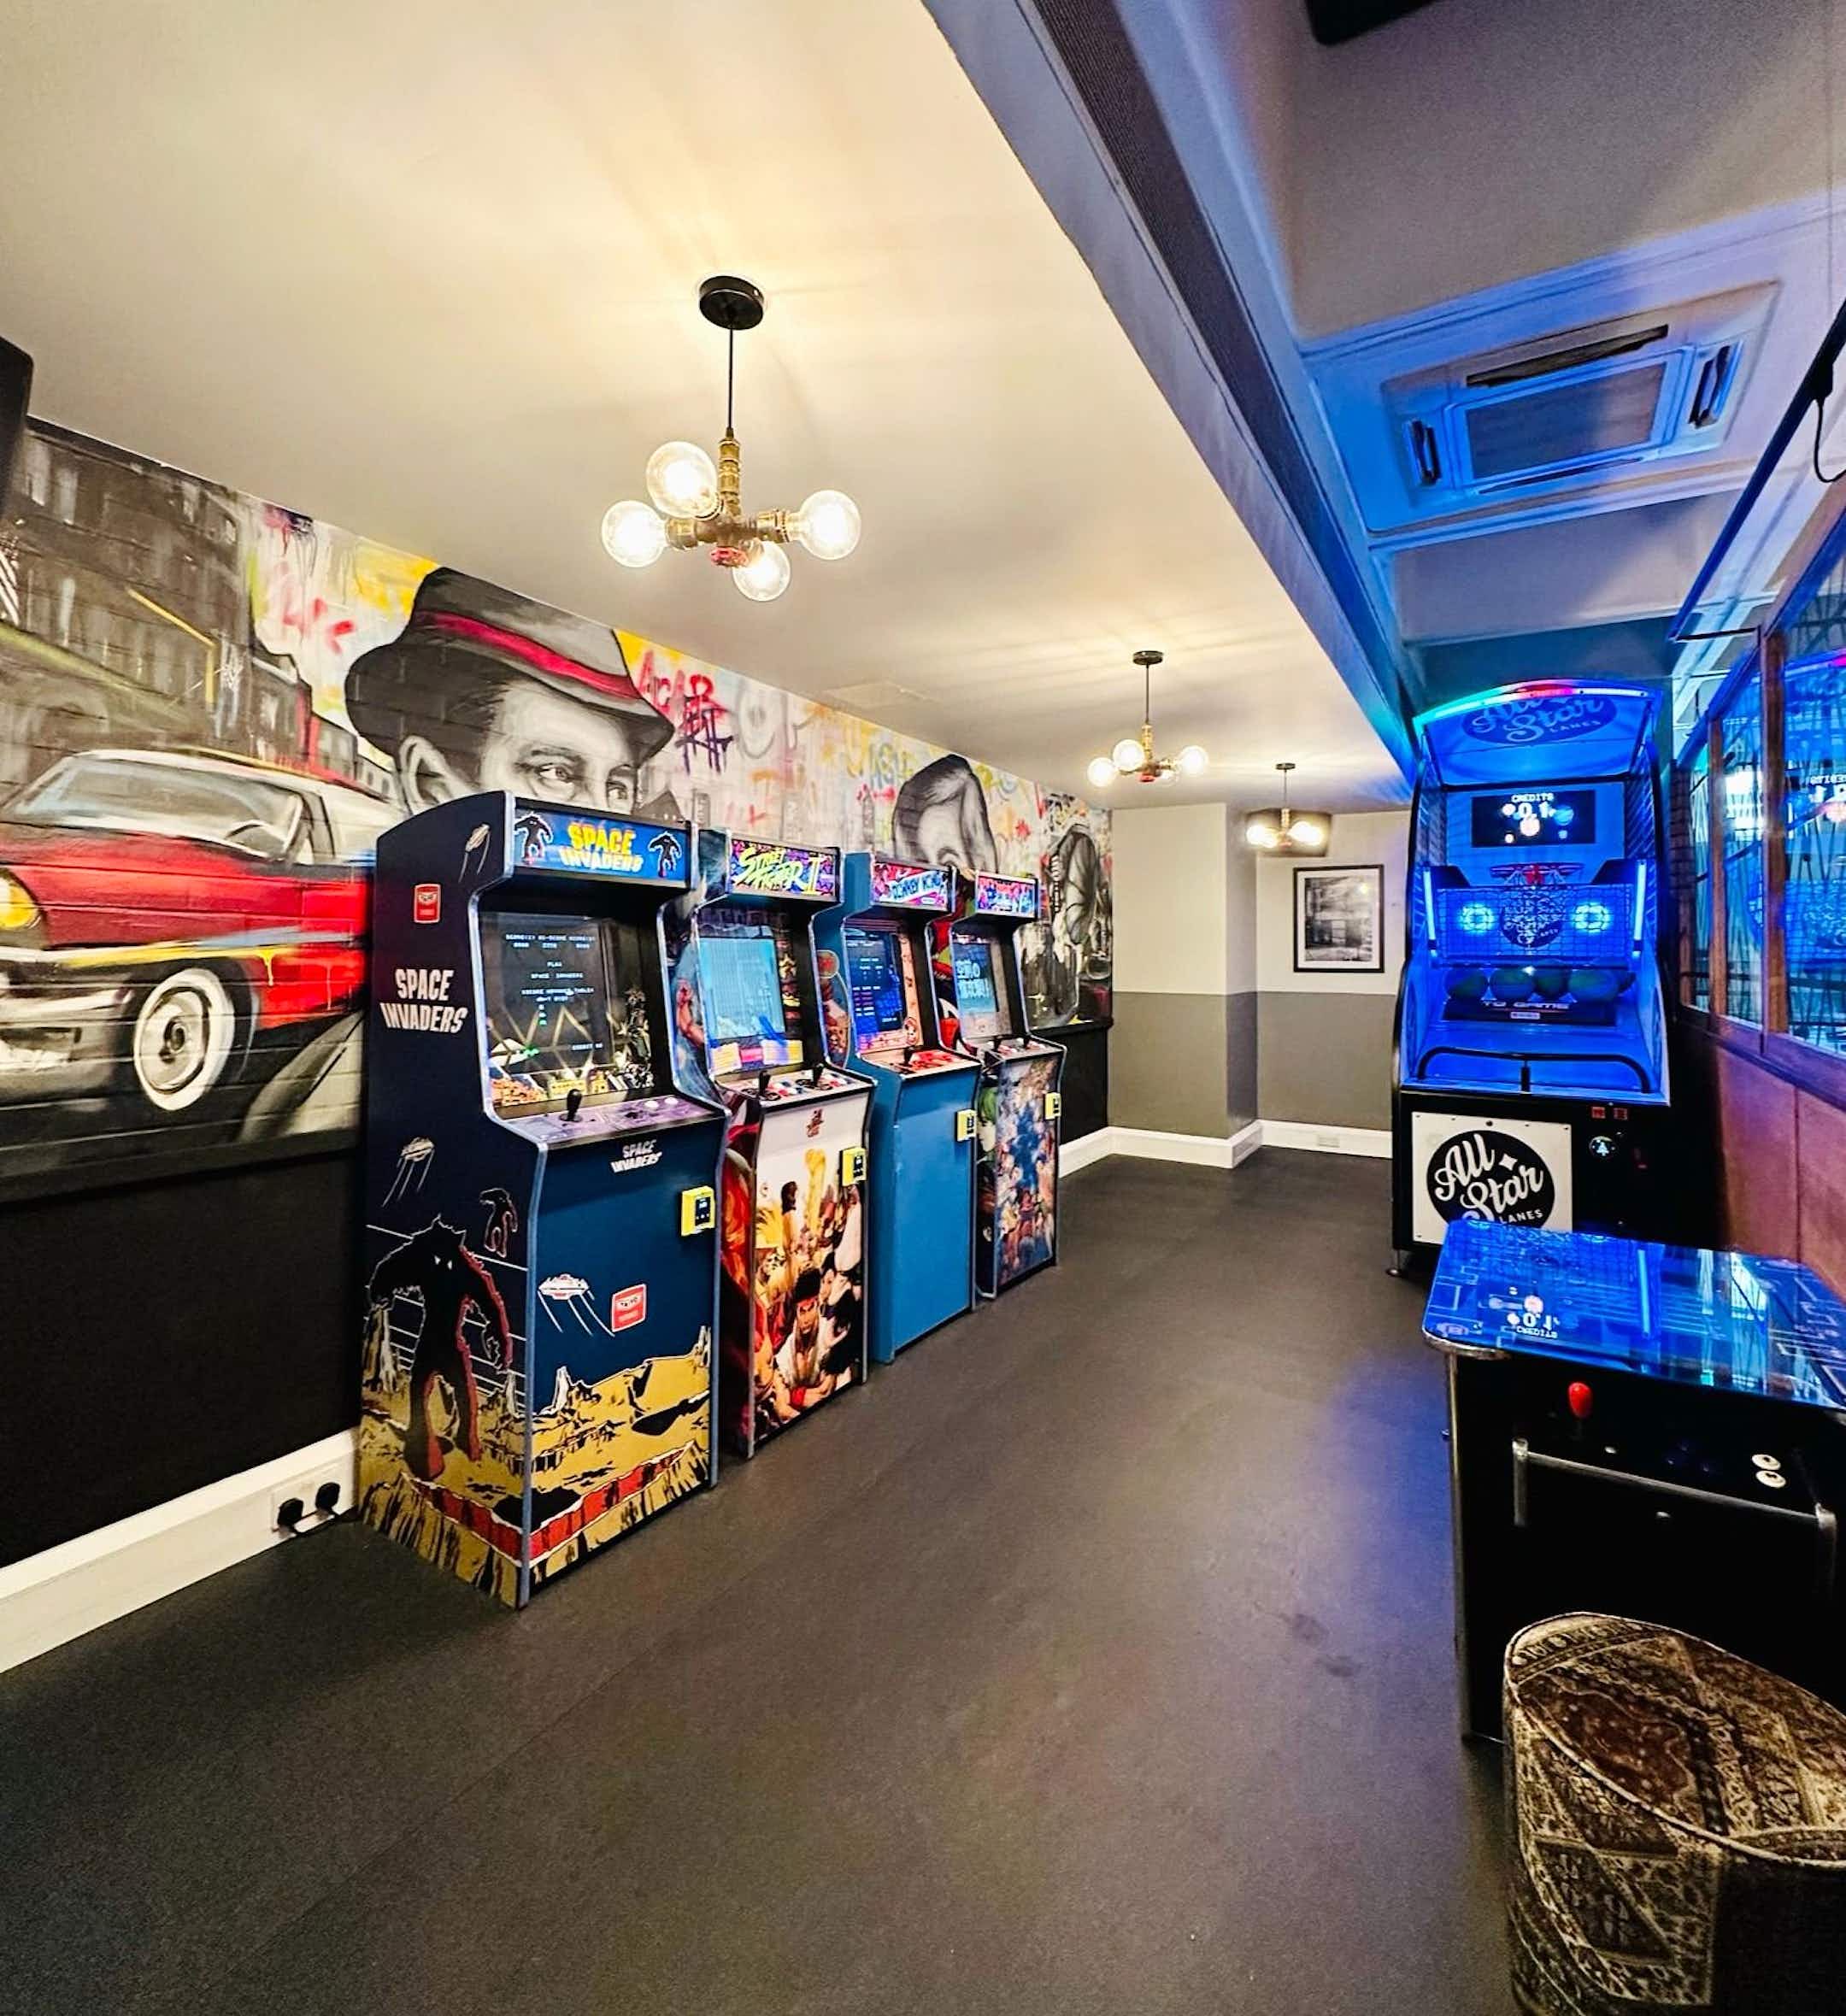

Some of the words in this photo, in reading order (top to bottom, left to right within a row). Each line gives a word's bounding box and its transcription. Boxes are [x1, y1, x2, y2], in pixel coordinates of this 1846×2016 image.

[1502, 694, 1604, 743] Star
[1511, 792, 1555, 803] CREDITS
[567, 821, 637, 855] SPACE
[558, 845, 644, 873] INVADERS
[395, 968, 455, 1001] SPACE
[379, 1002, 469, 1034] INVADERS
[610, 1150, 663, 1173] INVADERS
[622, 1138, 657, 1159] SPACE
[1434, 1133, 1496, 1202] All
[1459, 1165, 1544, 1222] Star
[1498, 1208, 1544, 1225] LANES
